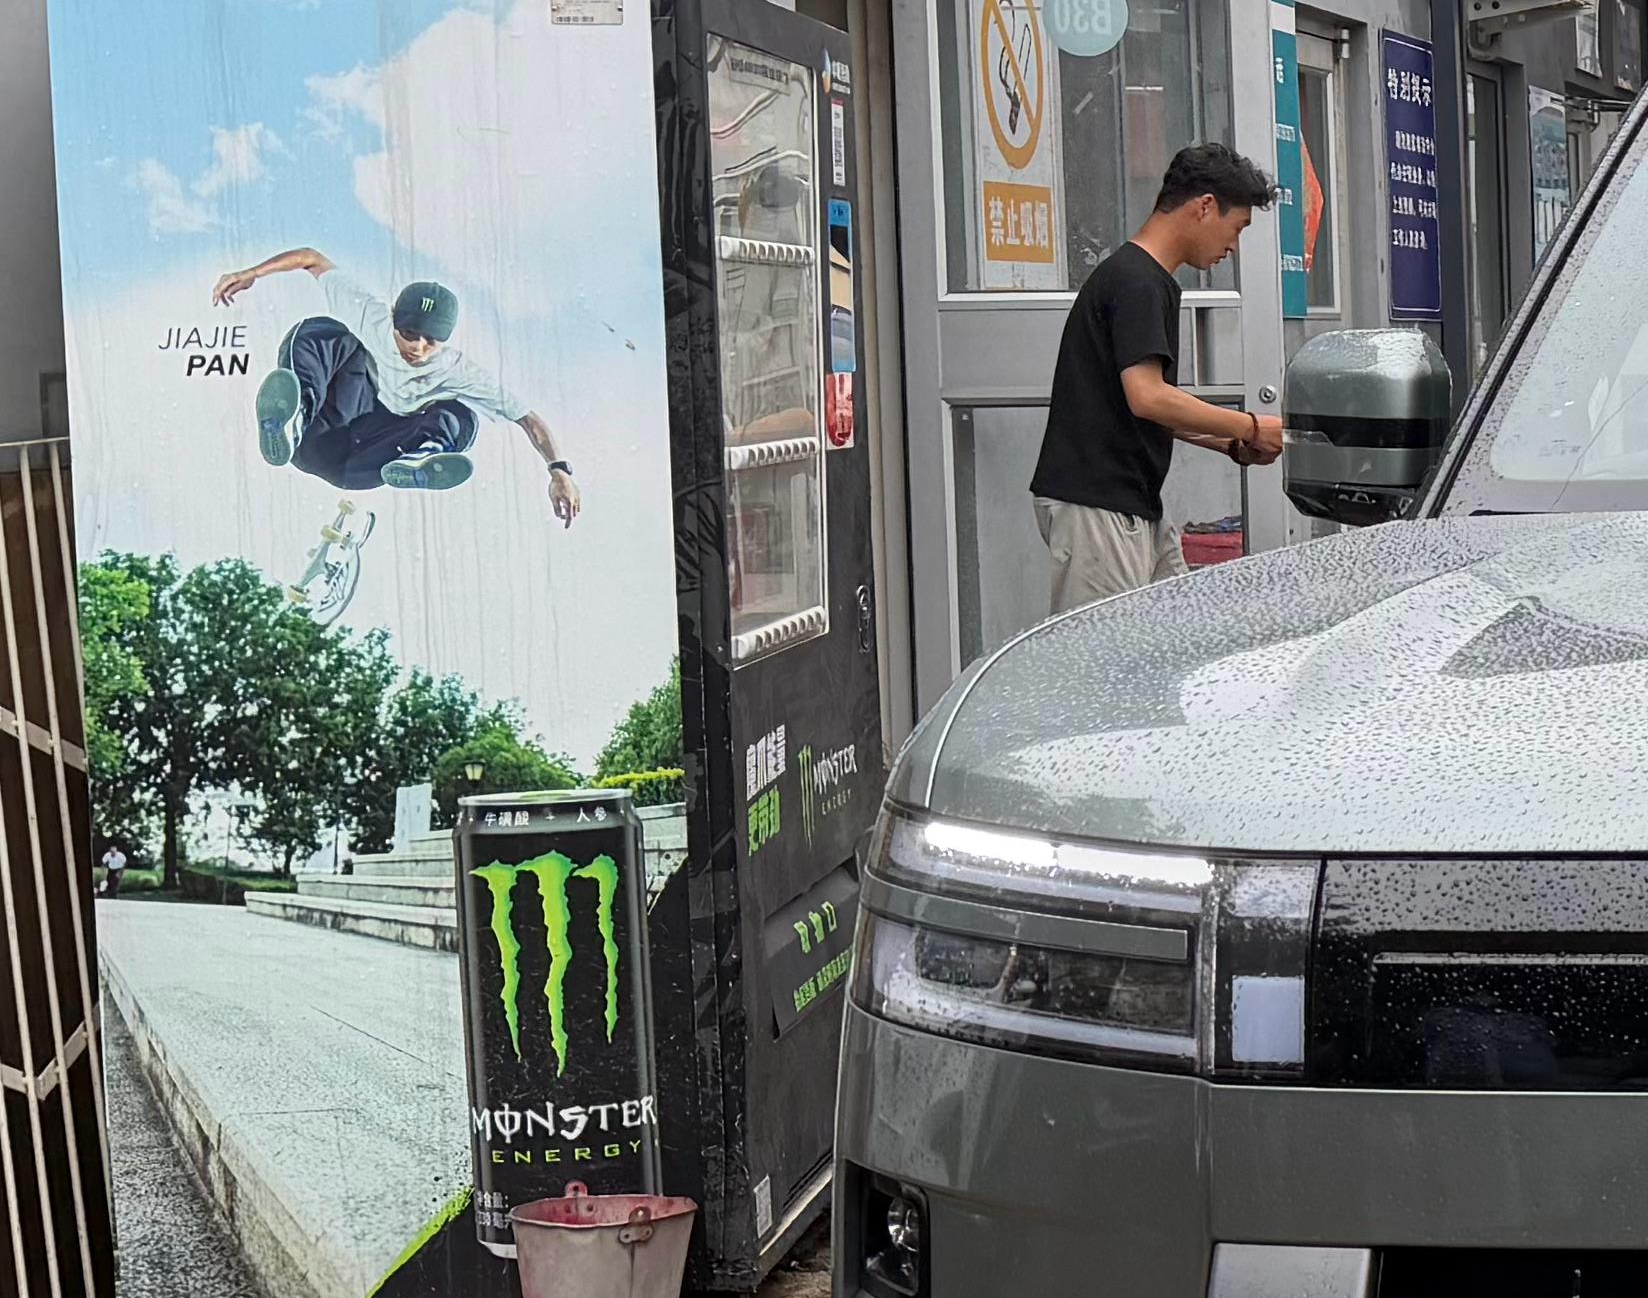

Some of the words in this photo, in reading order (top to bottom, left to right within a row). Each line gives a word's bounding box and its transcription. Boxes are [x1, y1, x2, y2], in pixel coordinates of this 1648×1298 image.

[989, 197, 1048, 248] 禁止吸烟
[158, 325, 247, 350] JIAJIE
[186, 353, 250, 377] PAN
[471, 1096, 657, 1143] MONSTER
[492, 1140, 641, 1163] ENERGY
